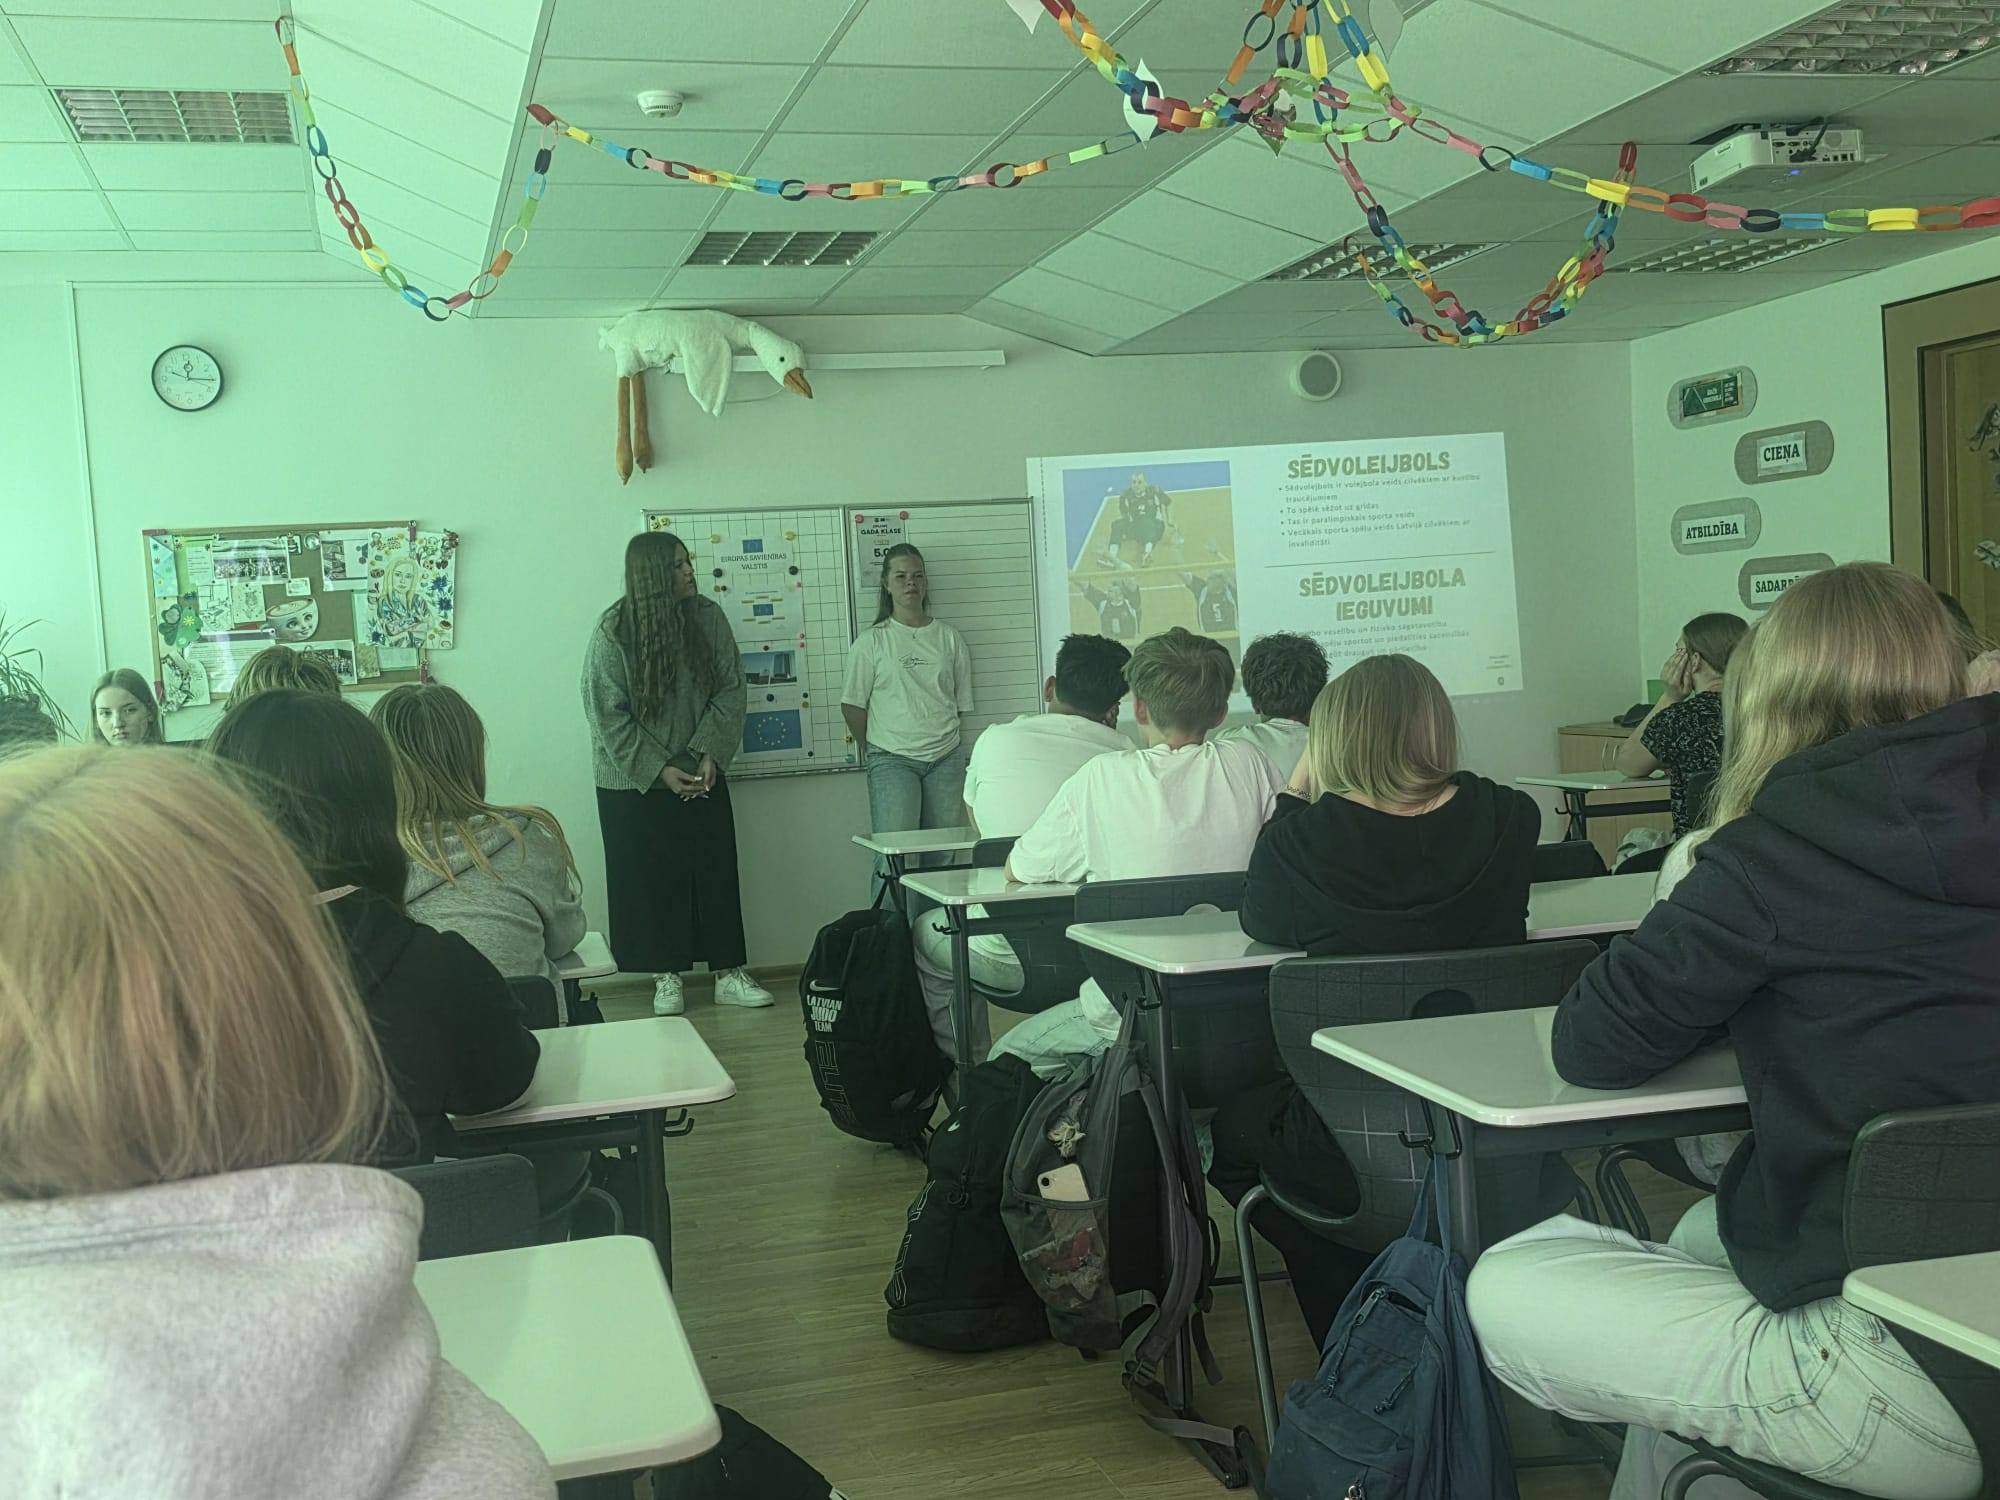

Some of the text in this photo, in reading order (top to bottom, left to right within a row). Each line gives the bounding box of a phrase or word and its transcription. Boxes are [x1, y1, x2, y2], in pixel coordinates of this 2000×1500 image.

[1763, 443, 1800, 462] CIEŅA
[1288, 452, 1450, 478] SĒDVOLEIJBOLS
[1686, 521, 1739, 539] ATBILDĪBA
[749, 553, 787, 562] SAVIENĪBAS
[1299, 568, 1466, 597] SĒDVOLEIJBOLA
[1336, 596, 1432, 621] IEGUVUMI
[807, 994, 842, 1010] LATVIAN
[811, 1006, 838, 1023] JUDO
[815, 1020, 833, 1032] TEAM
